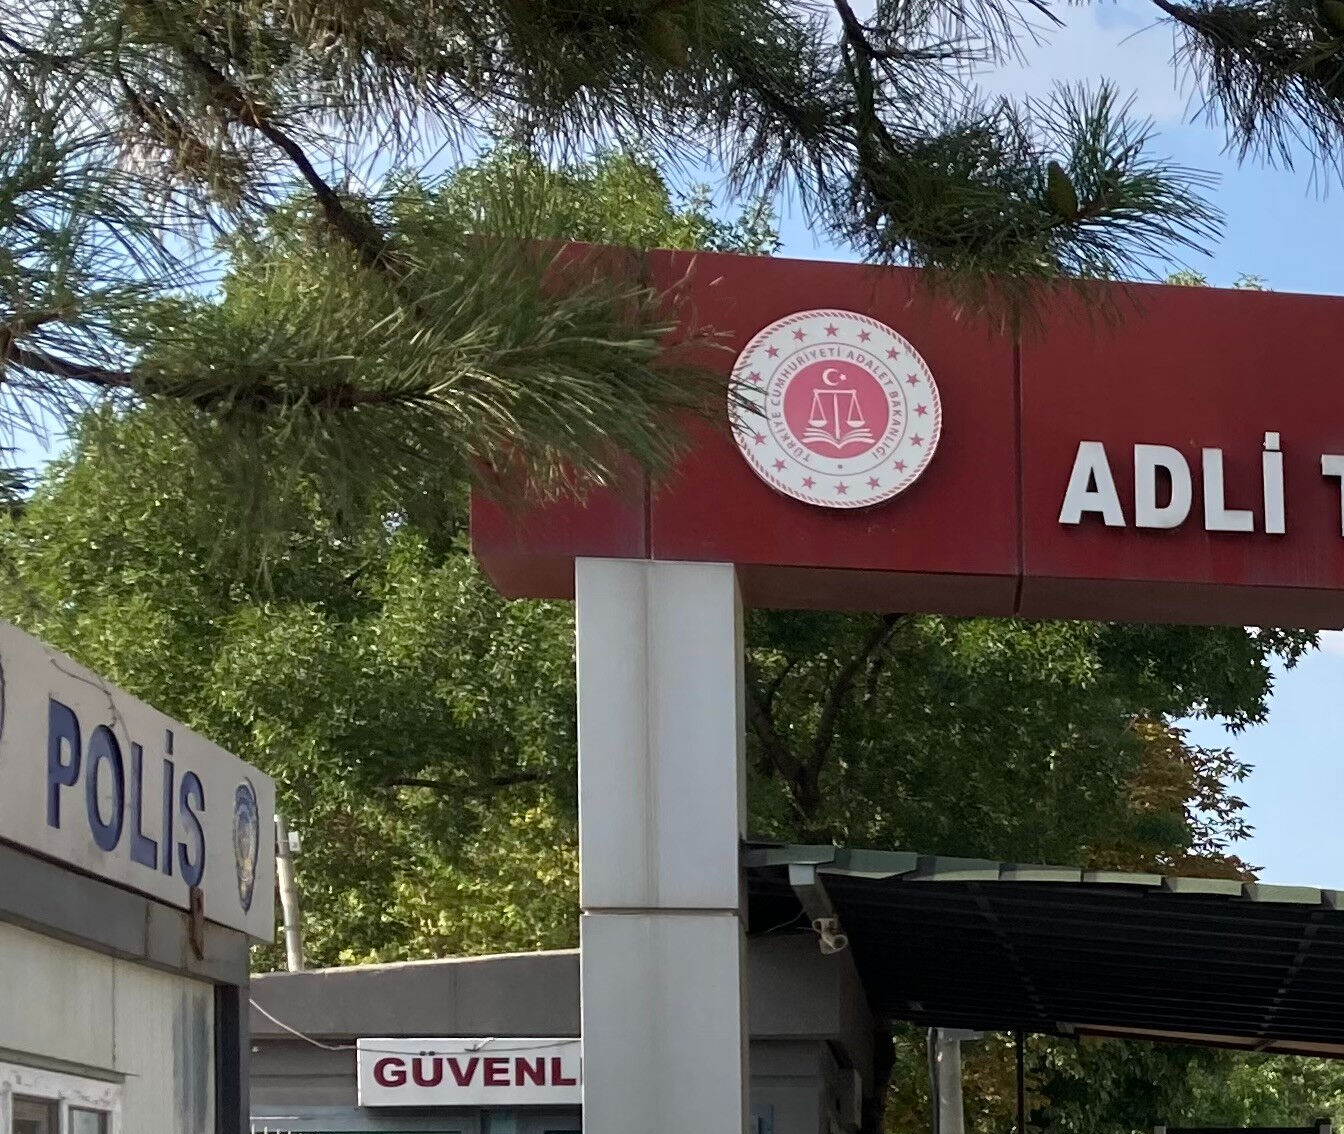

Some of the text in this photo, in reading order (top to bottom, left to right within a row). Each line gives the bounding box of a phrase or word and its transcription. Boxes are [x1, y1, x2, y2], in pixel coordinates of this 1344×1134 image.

[771, 347, 903, 462] TÜRKİYE CUMHURİYETİ ADALET BAKANLIĞI
[1058, 431, 1286, 534] ADLİ
[47, 696, 206, 888] POLİS
[373, 1050, 582, 1088] GÜVENL
